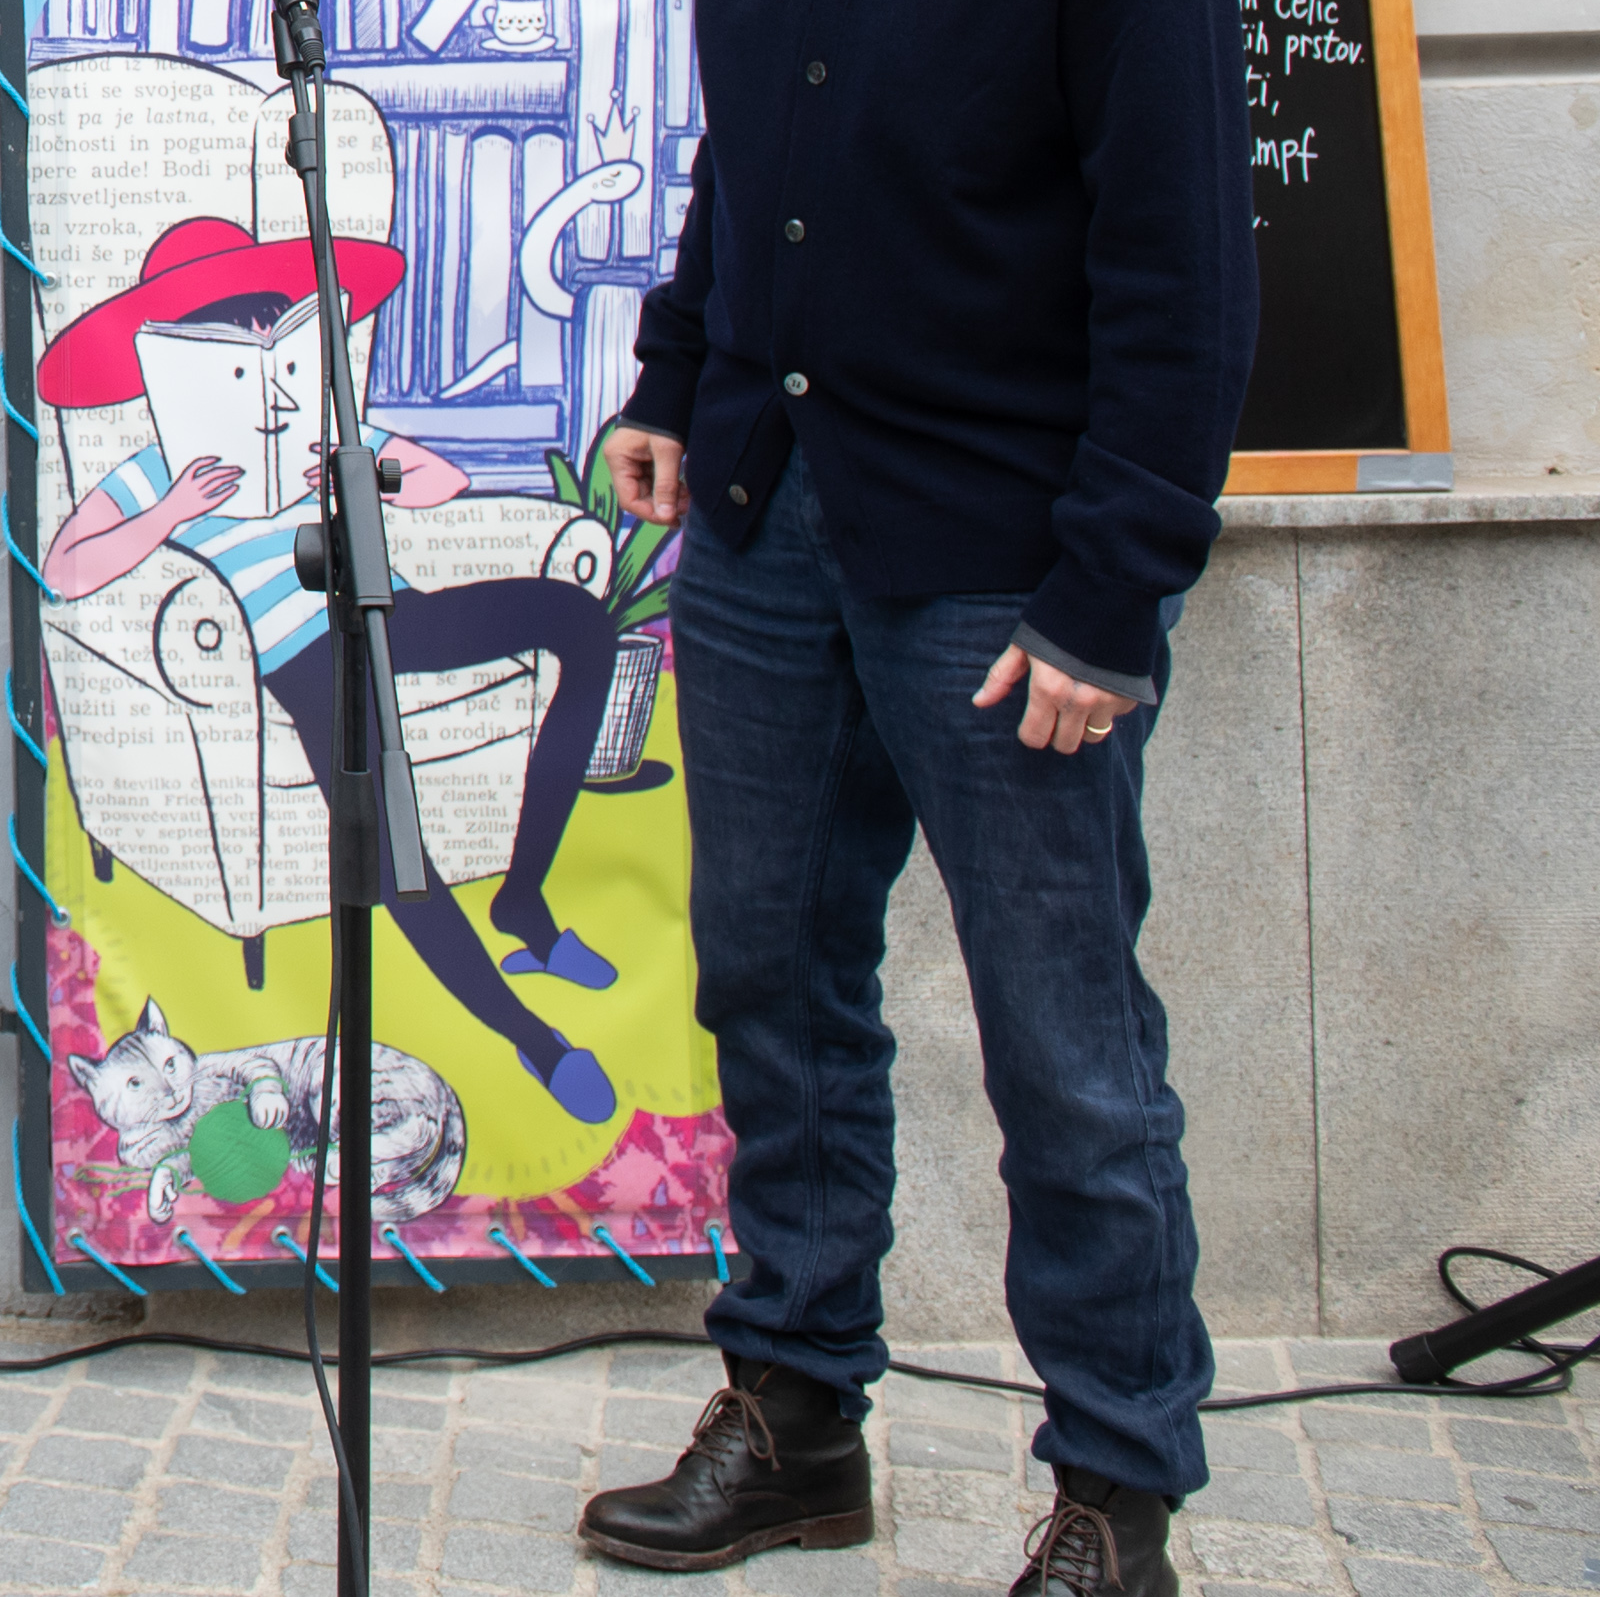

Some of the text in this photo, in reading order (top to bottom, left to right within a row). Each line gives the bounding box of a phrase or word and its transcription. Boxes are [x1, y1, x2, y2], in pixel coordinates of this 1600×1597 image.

[1285, 28, 1366, 77] prstov.
[102, 84, 123, 98] se
[134, 82, 215, 102] svojega
[78, 111, 103, 130] pa
[115, 107, 134, 129] je
[146, 106, 216, 126] lastna,
[227, 106, 249, 123] če
[129, 136, 150, 152] in
[163, 135, 253, 154] poguma,
[337, 134, 358, 148] se
[1250, 125, 1319, 186] mpf
[91, 160, 149, 179] aude!
[163, 159, 211, 178] Bodi
[64, 218, 143, 237] vzroka,
[38, 245, 81, 262] tudi
[91, 244, 114, 262] še
[78, 435, 104, 448] na
[427, 531, 540, 551] nevarnost,
[451, 562, 514, 577] ravno
[89, 615, 113, 633] od
[436, 674, 457, 686] se
[129, 703, 151, 716] se
[64, 724, 154, 749] Predpisi
[165, 726, 186, 744] in
[439, 720, 508, 742] orodja
[85, 793, 150, 807] Johann
